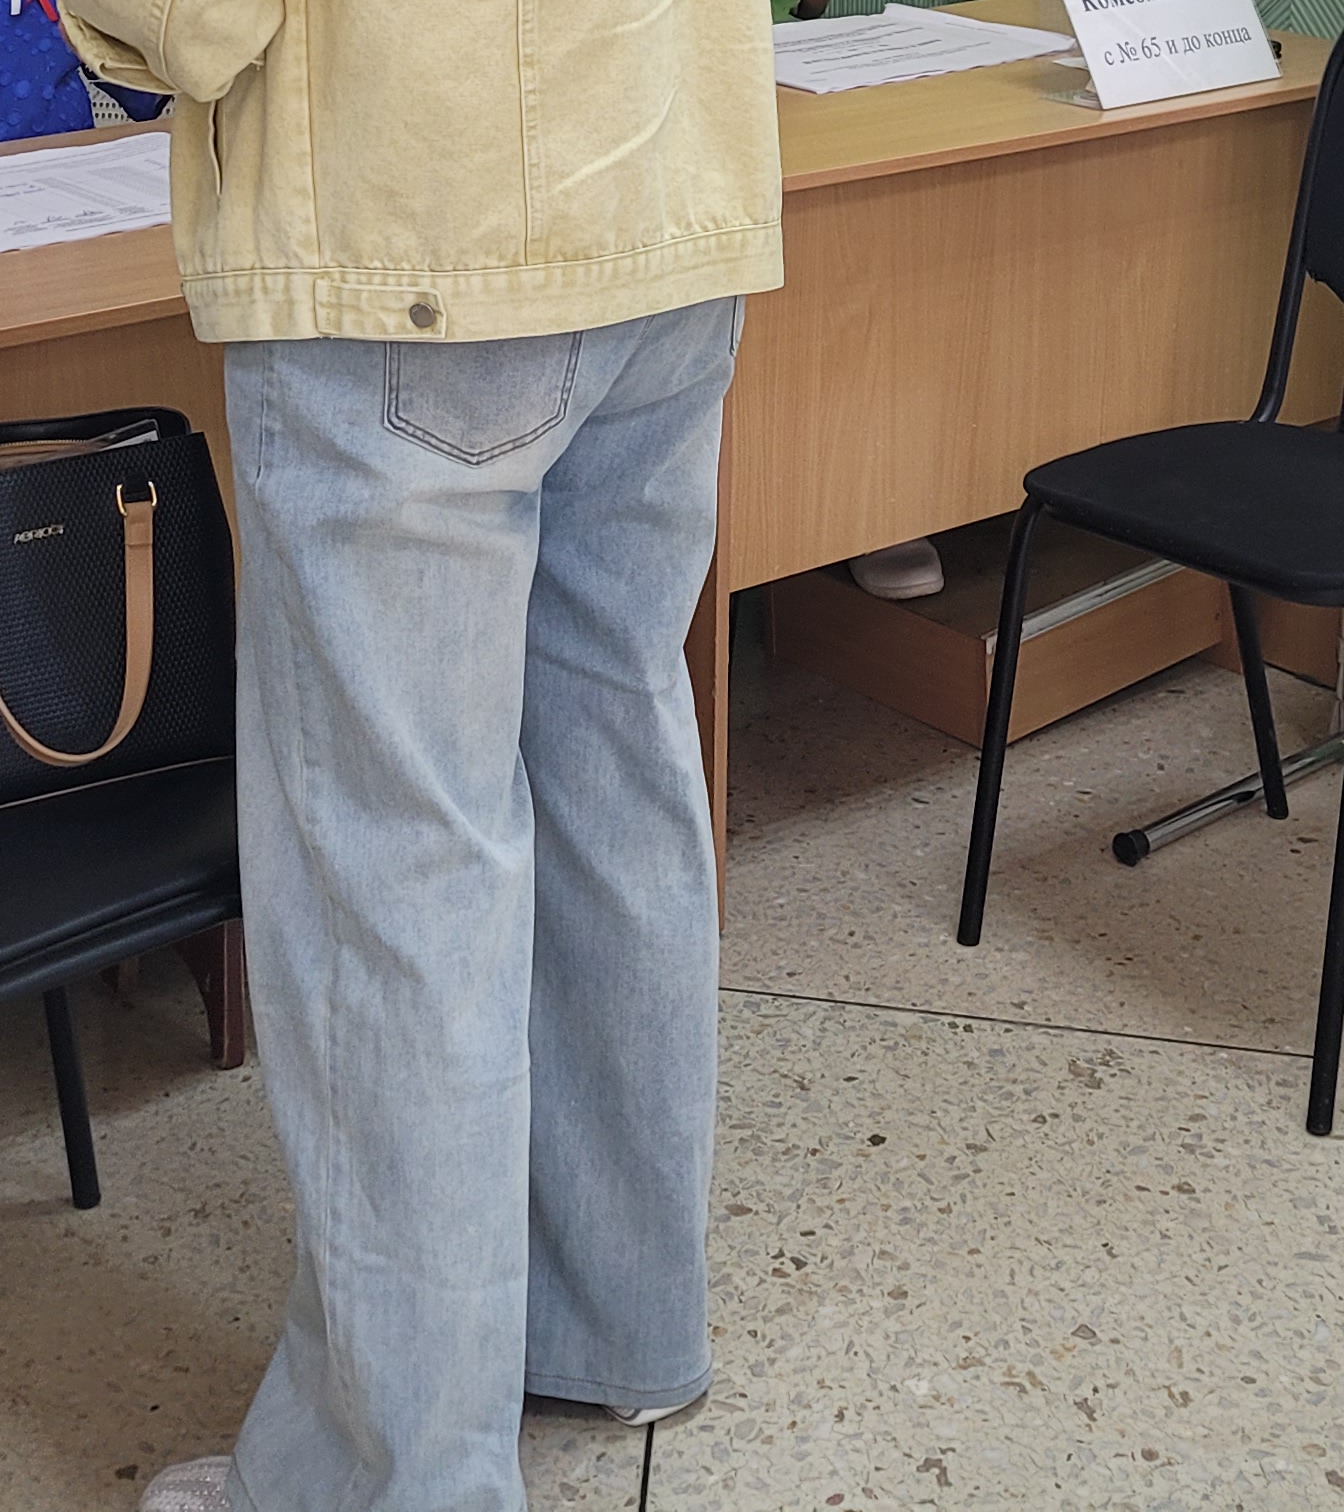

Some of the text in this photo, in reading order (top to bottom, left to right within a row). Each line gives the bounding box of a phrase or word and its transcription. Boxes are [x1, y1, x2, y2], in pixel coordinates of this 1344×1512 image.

[1104, 26, 1252, 66] с № 65 и до конца
